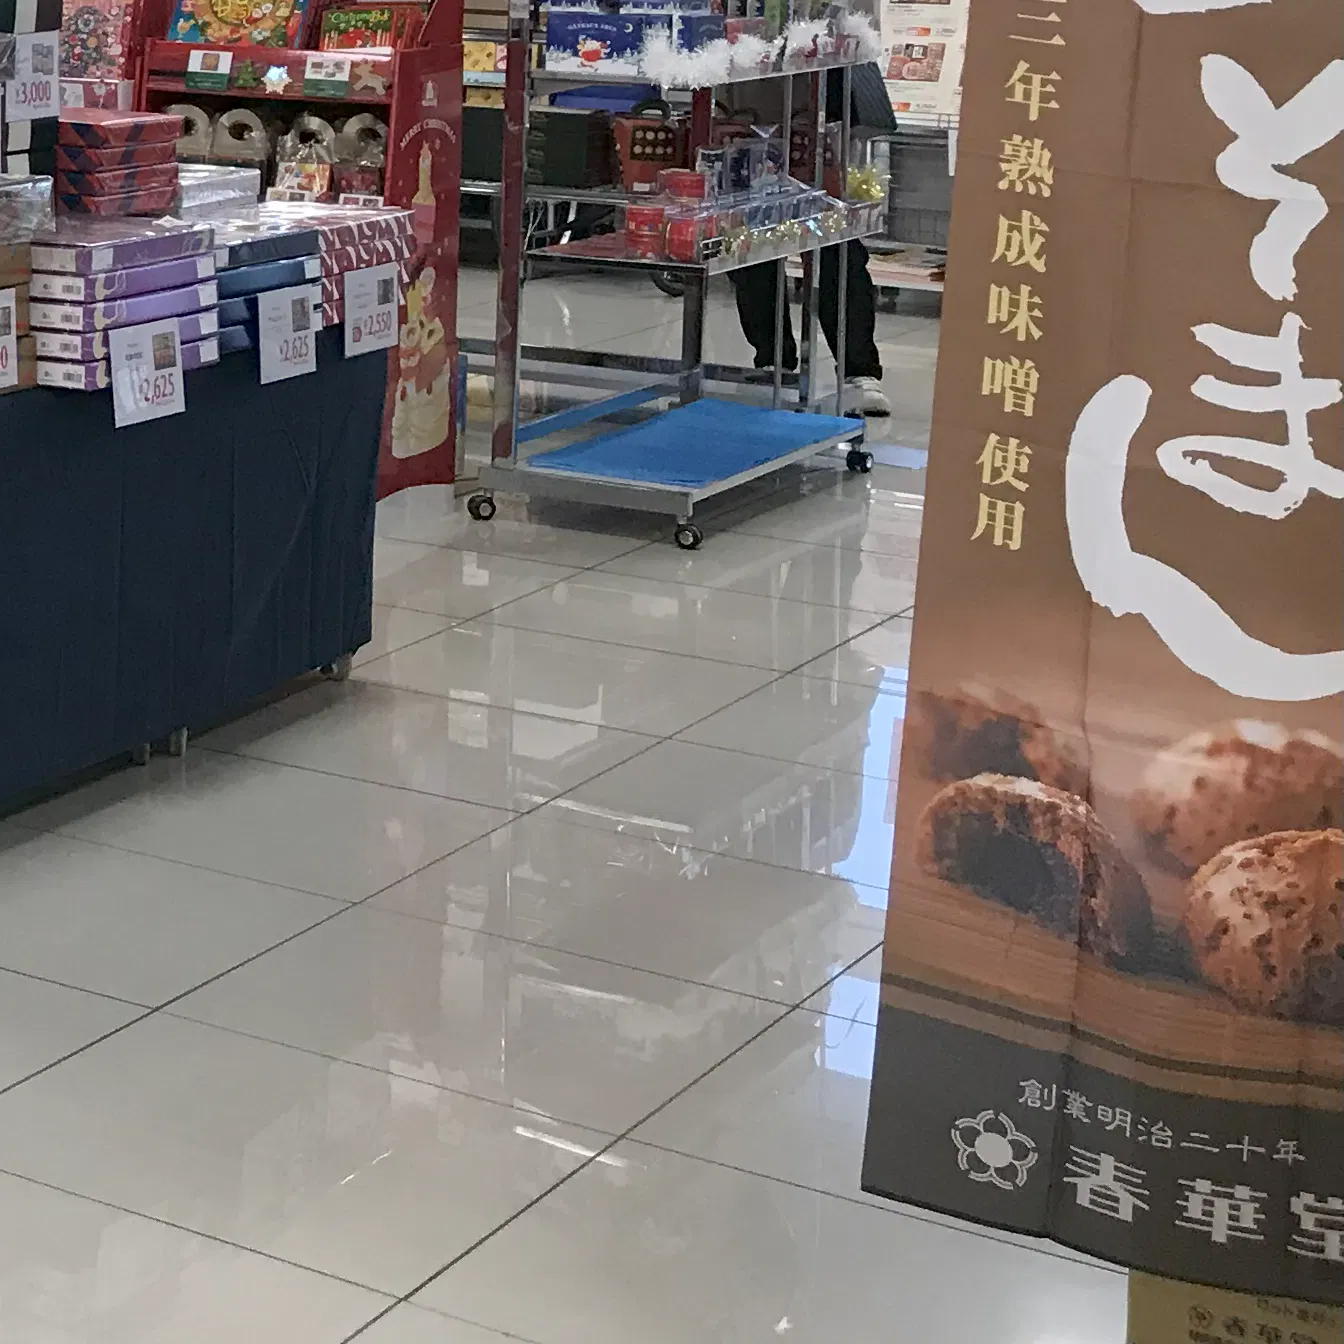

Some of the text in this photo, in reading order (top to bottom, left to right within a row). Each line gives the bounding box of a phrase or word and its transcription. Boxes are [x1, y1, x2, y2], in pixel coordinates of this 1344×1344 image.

[15, 80, 51, 104] ¥3,000
[1017, 1078, 1306, 1166] 創業明治二十年
[1063, 1145, 1344, 1262] 春華堂
